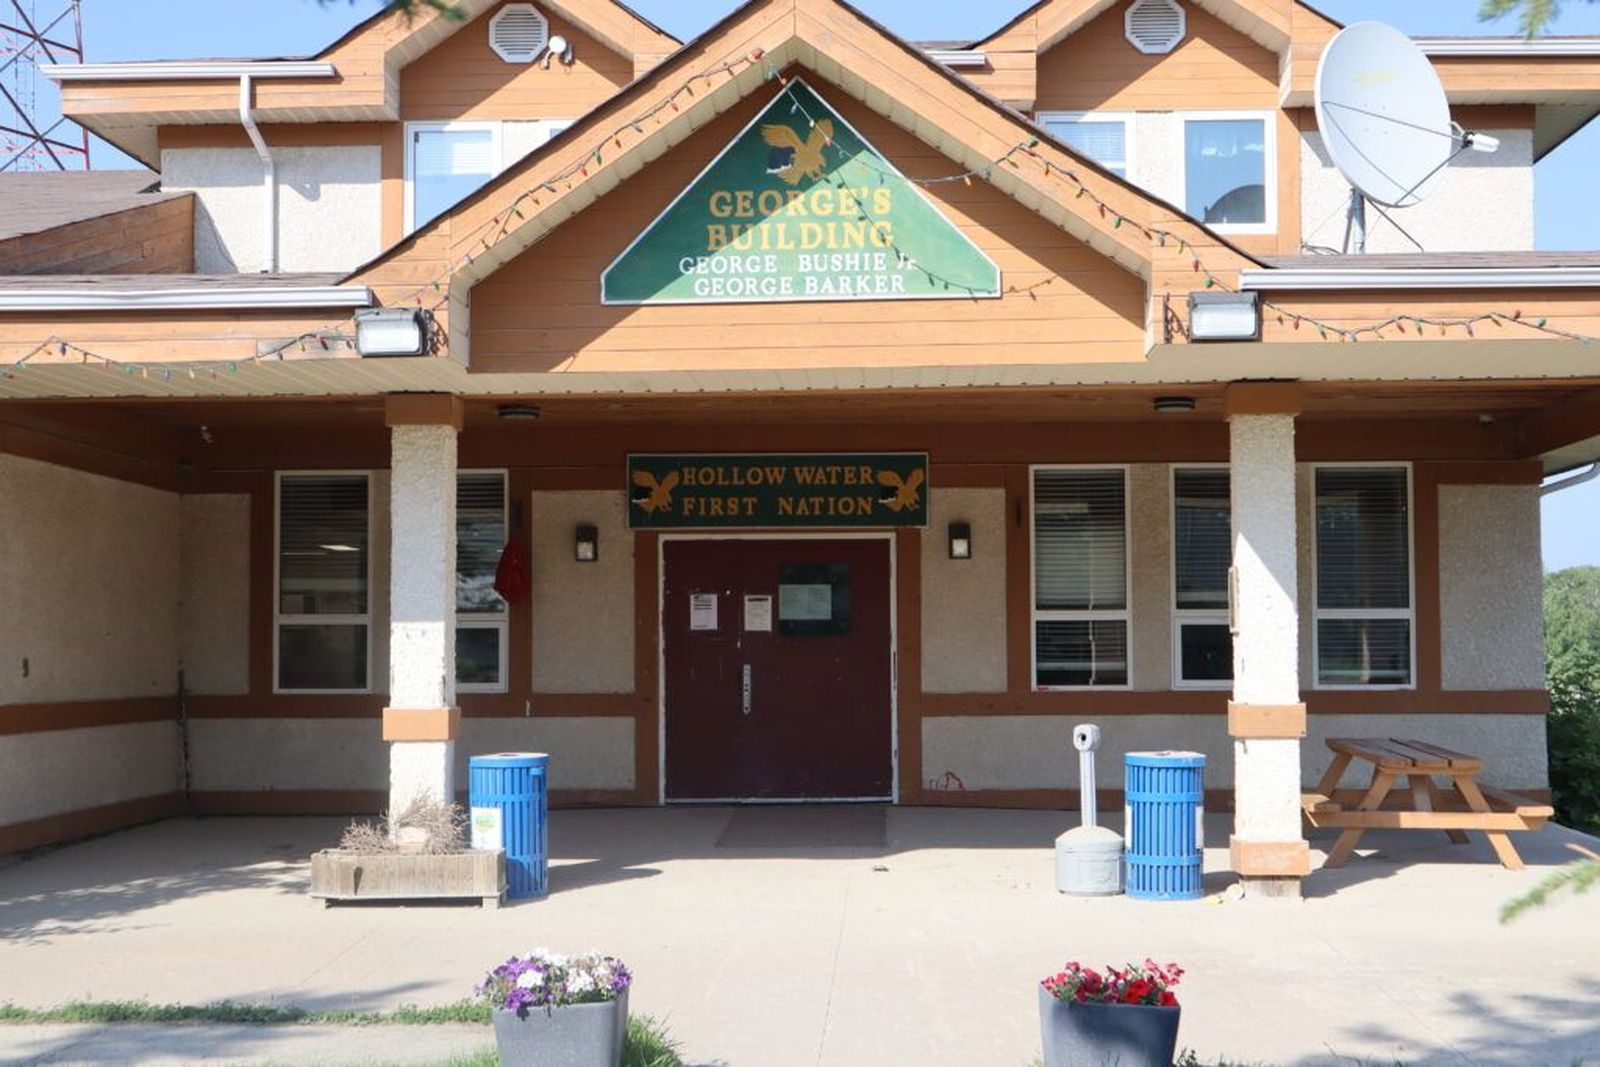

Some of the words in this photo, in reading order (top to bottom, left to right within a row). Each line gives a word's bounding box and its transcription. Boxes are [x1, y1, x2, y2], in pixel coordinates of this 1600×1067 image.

[709, 187, 891, 217] GEORGE'S
[707, 221, 892, 251] BUILDING
[679, 255, 778, 275] GEORGE
[799, 252, 886, 273] BUSHIE
[694, 276, 793, 296] GEORGE
[805, 274, 906, 294] BARKER
[682, 466, 786, 486] HOLLOW
[793, 465, 874, 485] WATER
[682, 497, 758, 516] FIRST
[777, 496, 873, 516] NATION
